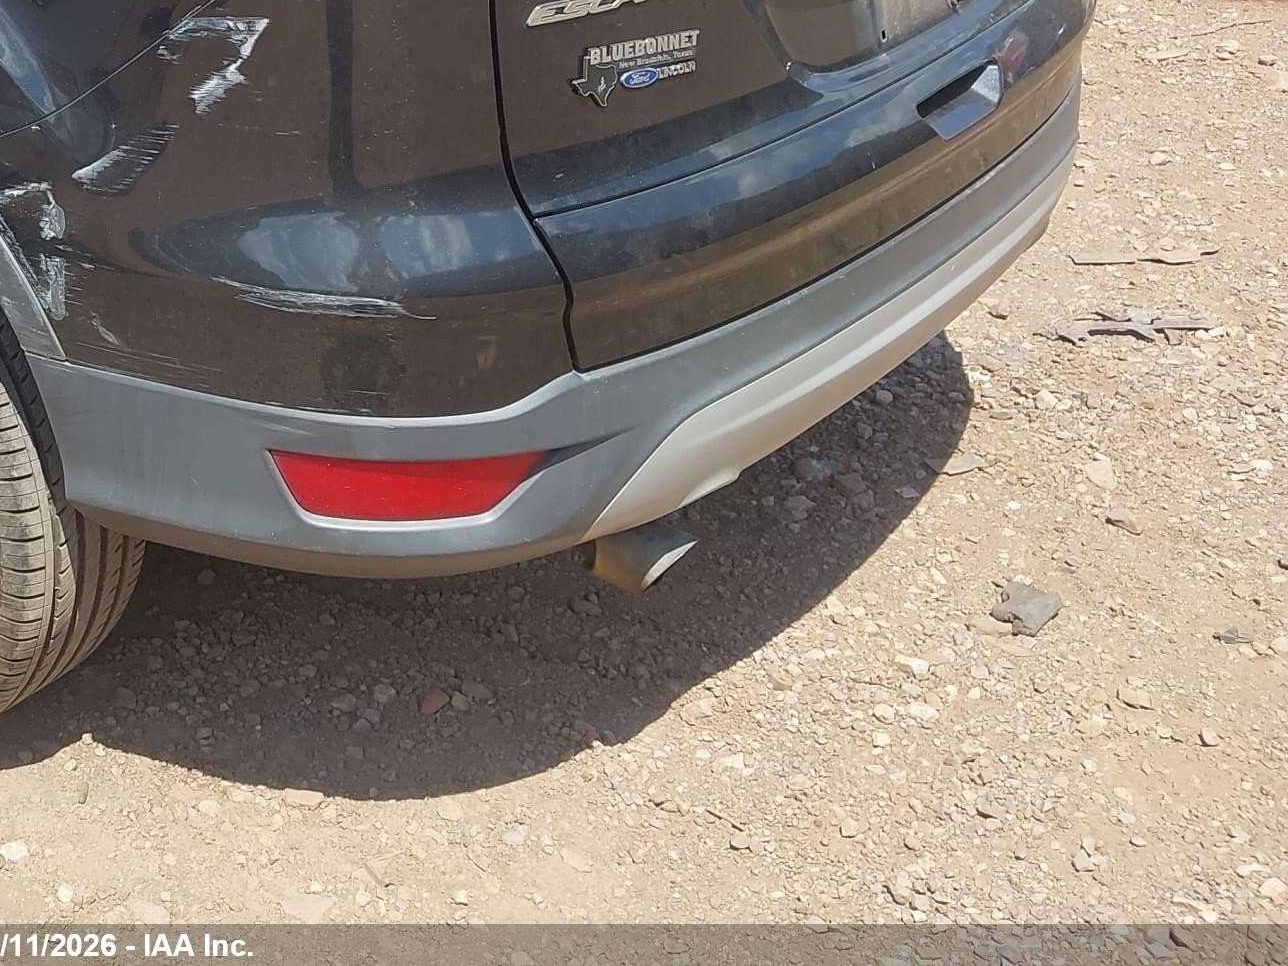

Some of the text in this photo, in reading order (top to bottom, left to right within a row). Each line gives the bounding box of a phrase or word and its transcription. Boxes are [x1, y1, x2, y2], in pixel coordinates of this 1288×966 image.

[588, 29, 700, 66] BLUEBONNET
[619, 59, 636, 69] New
[656, 60, 696, 79] LINCOLN
